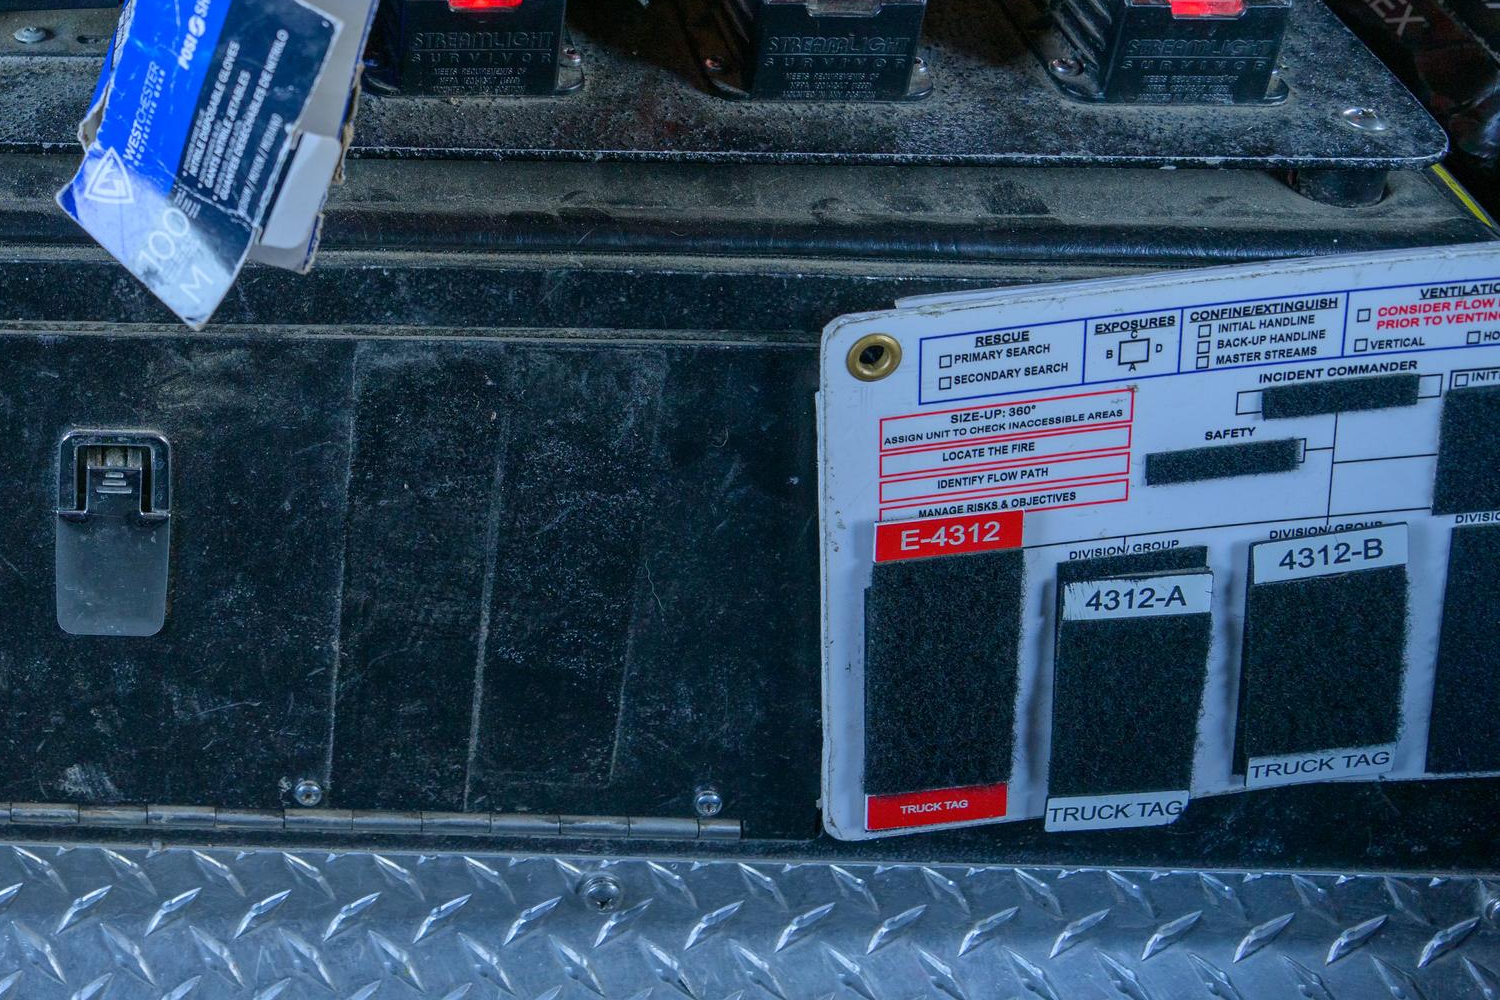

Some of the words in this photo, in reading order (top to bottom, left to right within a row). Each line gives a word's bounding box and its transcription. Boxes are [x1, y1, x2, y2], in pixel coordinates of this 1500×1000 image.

[178, 33, 198, 71] POSI
[122, 60, 160, 161] WESTCHESTER
[139, 207, 190, 271] 100
[179, 265, 213, 304] M
[1378, 300, 1451, 317] CONSIDER
[1454, 298, 1491, 312] FLOW
[975, 330, 1030, 346] RESCUE
[1095, 316, 1176, 333] EXPOSURES
[1190, 298, 1338, 322] CONFINE/EXTINGUISH
[1218, 320, 1256, 333] INITIAL
[1258, 314, 1315, 329] HANDLINE
[1376, 316, 1419, 330] PRIOR
[1424, 315, 1442, 327] TO
[1217, 336, 1266, 350] BACK-UP
[1270, 330, 1326, 344] HANDLINE
[1370, 337, 1425, 350] VERTICAL
[954, 350, 1003, 364] PRIMARY
[1006, 344, 1050, 357] SEARCH
[1216, 351, 1262, 365] MASTER
[1265, 346, 1318, 360] STREAMS
[954, 367, 1020, 385] SECONDARY
[1023, 362, 1068, 375] SEARCH
[1259, 368, 1324, 384] INCIDENT
[1327, 360, 1418, 377] COMMANDER
[884, 430, 923, 445] ASSIGN
[926, 429, 950, 439] UNIT
[953, 427, 967, 436] TO
[970, 423, 1006, 435] CHECK
[1009, 413, 1085, 429] INACCESSIBLE
[1087, 409, 1123, 420] AREAS
[950, 409, 1006, 424] SIZE-UP:
[1205, 426, 1256, 441] SAFETY
[942, 448, 985, 462] LOCATE
[988, 445, 1009, 457] THE
[1011, 442, 1035, 453] FIRE
[937, 474, 985, 489] IDENTIFY
[987, 470, 1018, 483] FLOW
[1020, 467, 1049, 479] PATH
[919, 505, 964, 518] MANAGE
[967, 501, 998, 513] RISKS
[1000, 500, 1009, 510] &
[1011, 491, 1077, 508] OBJECTIVES
[901, 520, 1000, 551] E-4312
[1132, 539, 1180, 553] GROUP
[1279, 537, 1384, 571] 4312-B
[1085, 585, 1187, 612] 4312-A
[1249, 757, 1335, 780] TRUCK
[1341, 751, 1391, 770] TAG
[899, 802, 942, 815] TRUCK
[945, 799, 968, 811] TAG
[1049, 803, 1132, 824] TRUCK
[1137, 800, 1185, 819] TAG
